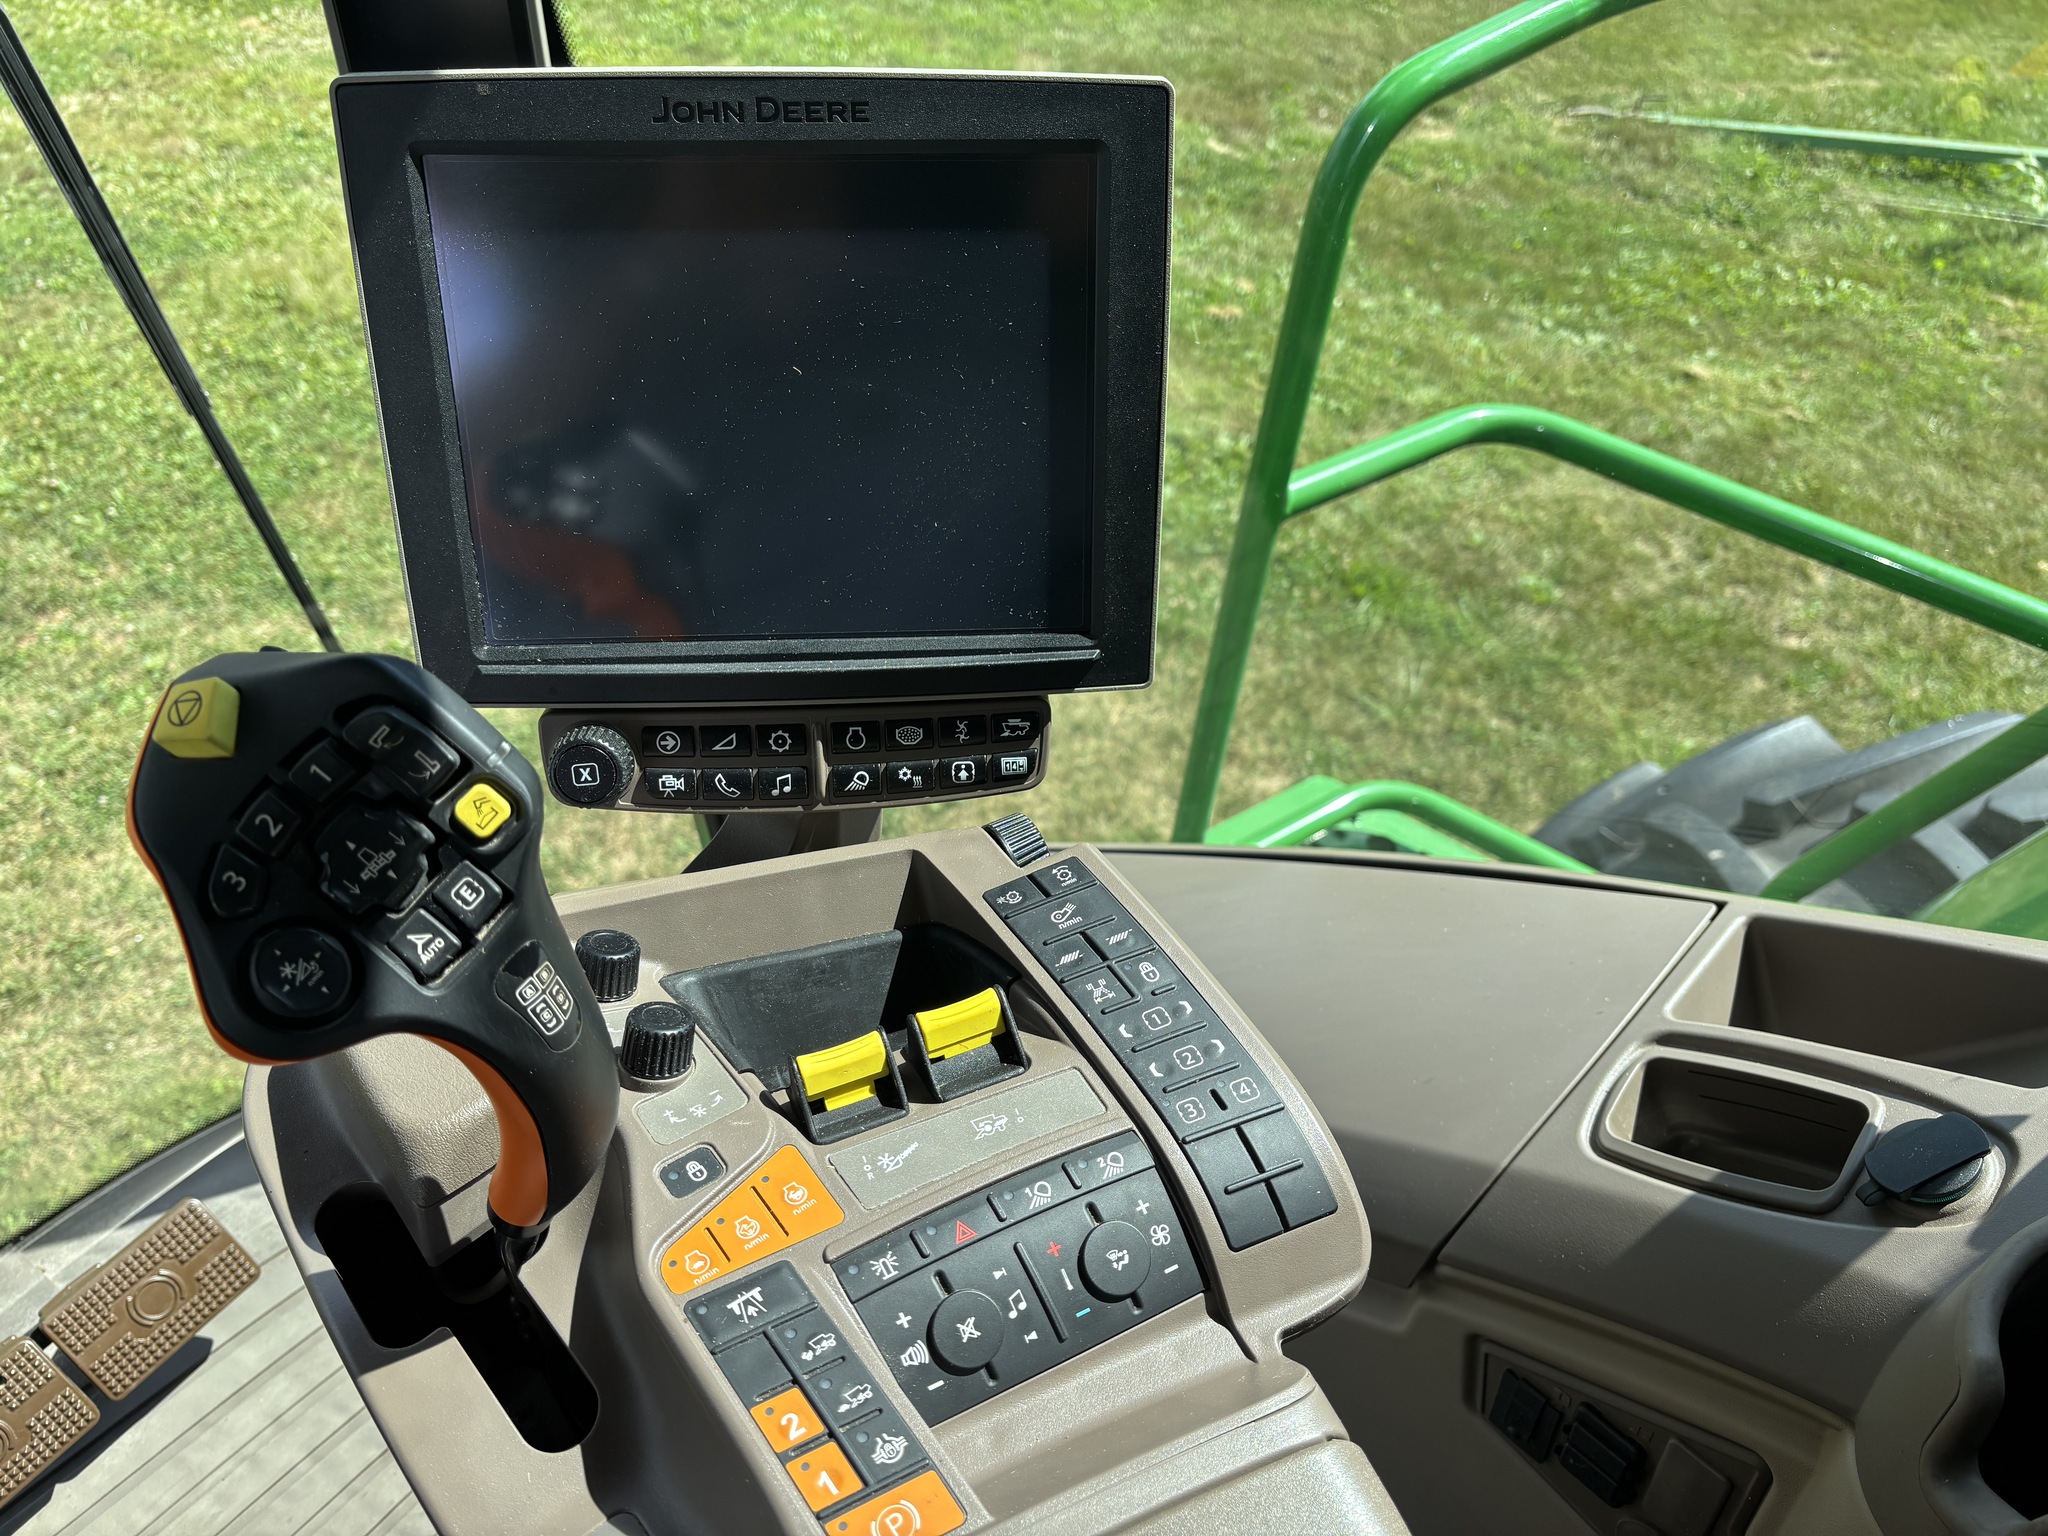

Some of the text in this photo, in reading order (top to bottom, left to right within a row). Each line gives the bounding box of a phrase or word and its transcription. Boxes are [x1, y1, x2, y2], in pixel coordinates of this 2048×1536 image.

[651, 96, 870, 124] JOHN DEERE
[310, 764, 332, 783] 1
[255, 814, 283, 838] 2
[222, 871, 247, 893] 3
[459, 885, 477, 902] E
[1058, 916, 1083, 930] n/min
[420, 936, 445, 964] AUTO
[1151, 1013, 1162, 1025] 1
[1181, 1052, 1196, 1066] 2
[1240, 1082, 1251, 1096] 4
[1184, 1103, 1198, 1118] 3
[1097, 1157, 1107, 1168] 2
[1025, 1187, 1032, 1197] 1
[792, 1198, 817, 1216] n/min
[744, 1232, 770, 1251] n/min
[693, 1266, 720, 1285] n/min
[780, 1413, 807, 1441] 2
[818, 1470, 839, 1495] 1
[885, 1512, 903, 1536] P
